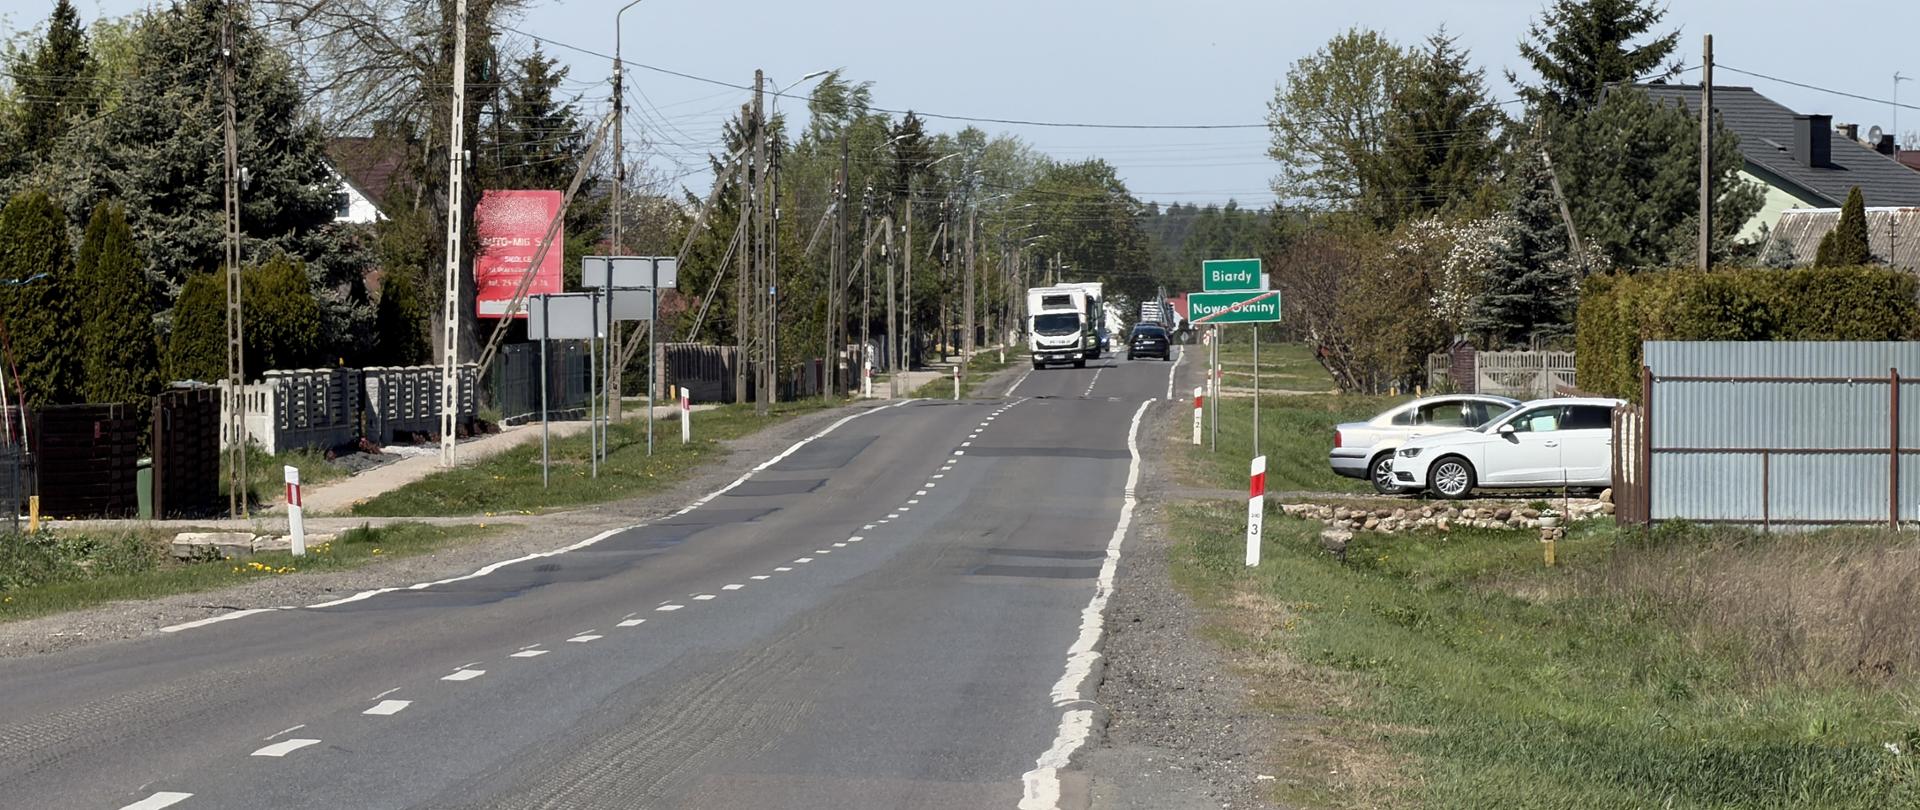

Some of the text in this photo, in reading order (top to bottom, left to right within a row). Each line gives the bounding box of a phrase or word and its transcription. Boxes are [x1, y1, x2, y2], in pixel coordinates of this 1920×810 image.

[1212, 270, 1252, 284] Biardy
[1193, 301, 1275, 315] Nowe Okniny
[1251, 523, 1259, 536] 3
